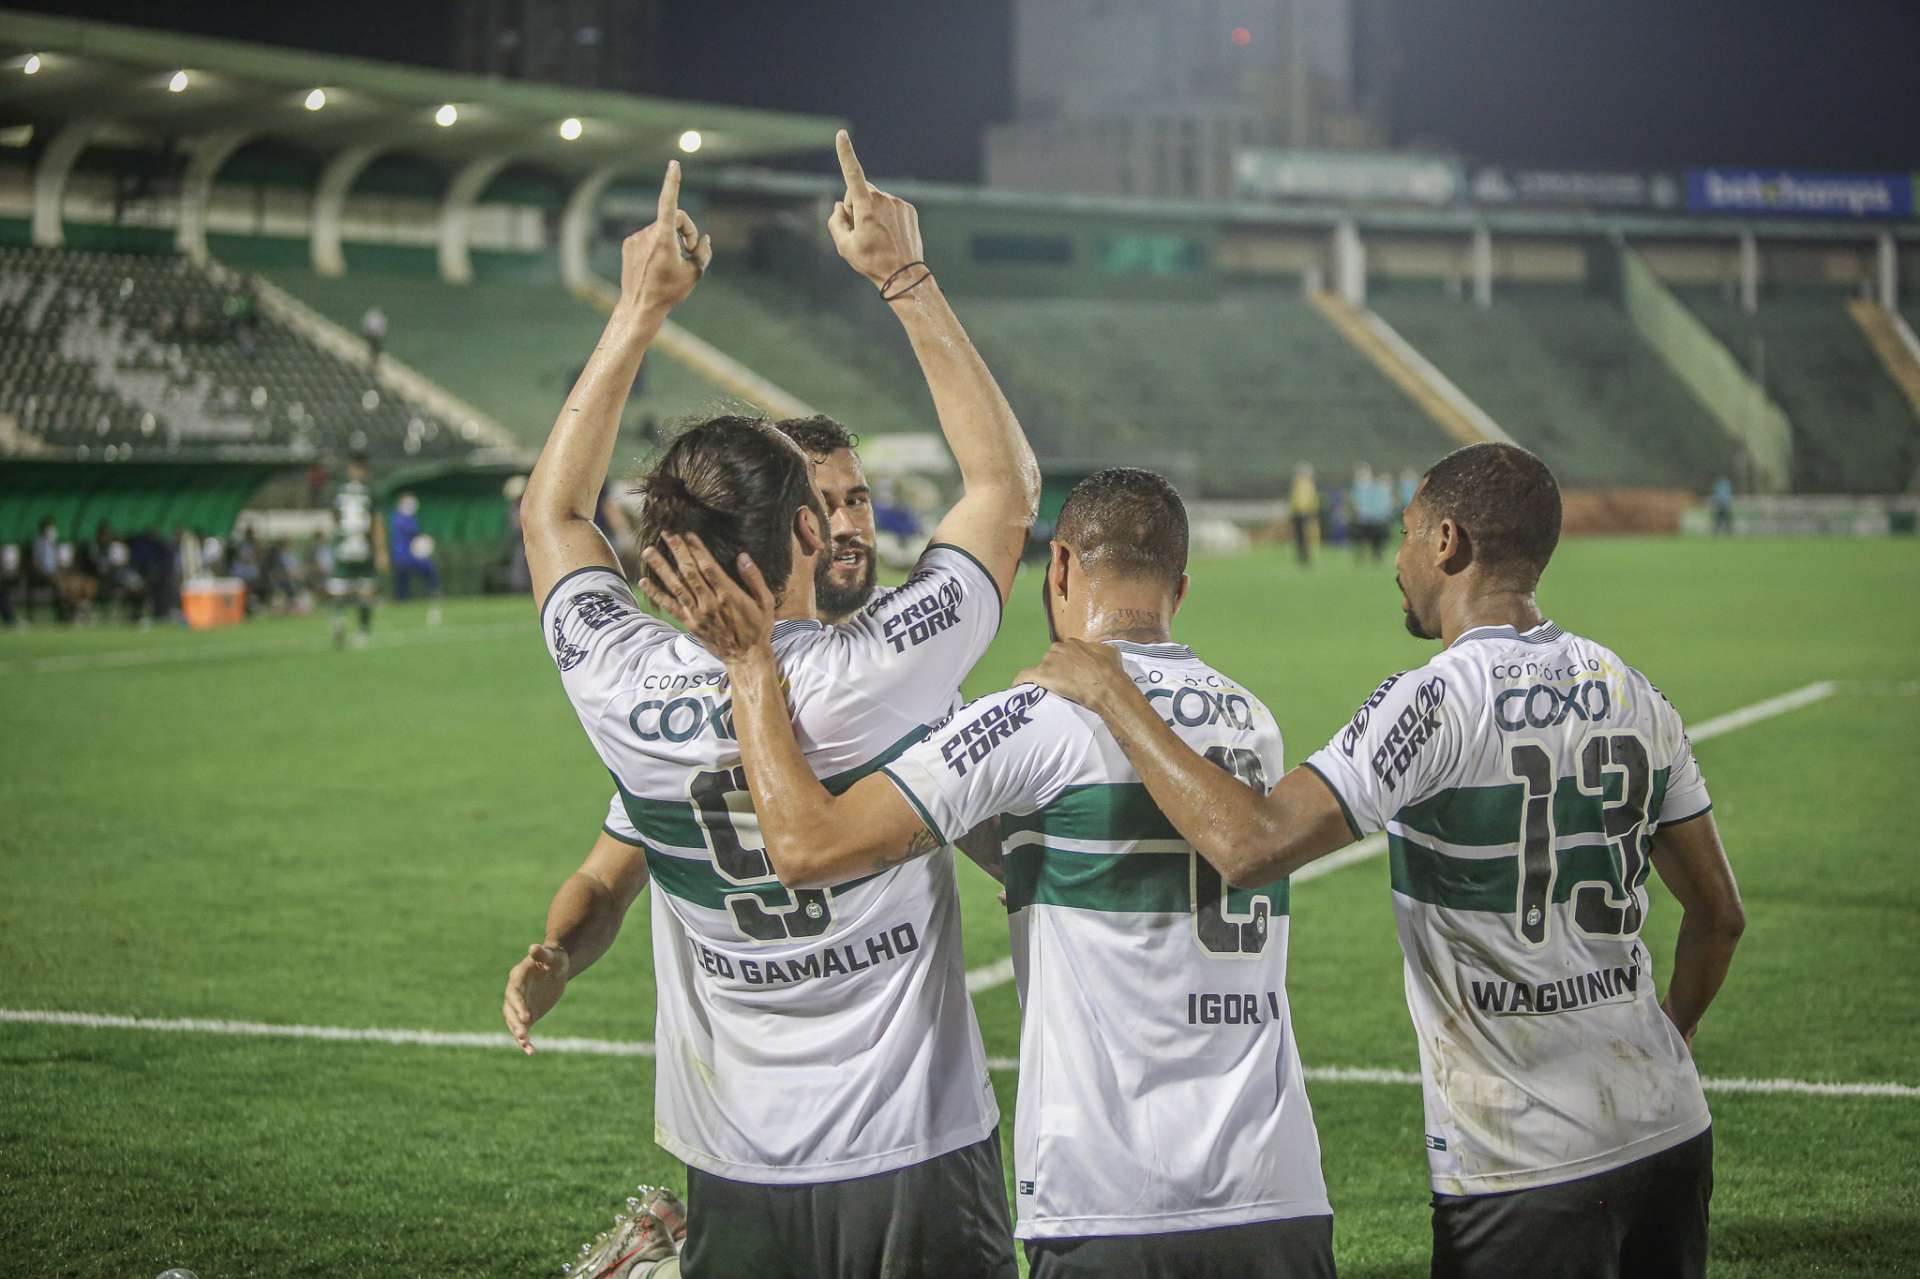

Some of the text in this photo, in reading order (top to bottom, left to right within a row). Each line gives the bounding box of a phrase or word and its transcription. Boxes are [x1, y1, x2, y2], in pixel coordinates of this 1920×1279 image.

[883, 594, 939, 638] PRO
[887, 603, 961, 654] TORK
[940, 705, 1004, 762] PRO
[948, 707, 1034, 778] TORK
[1371, 705, 1418, 779] PRO
[1383, 709, 1442, 793] TORK
[1504, 728, 1653, 949] 13
[739, 922, 920, 985] GAMALHO
[1188, 993, 1262, 1025] IGOR
